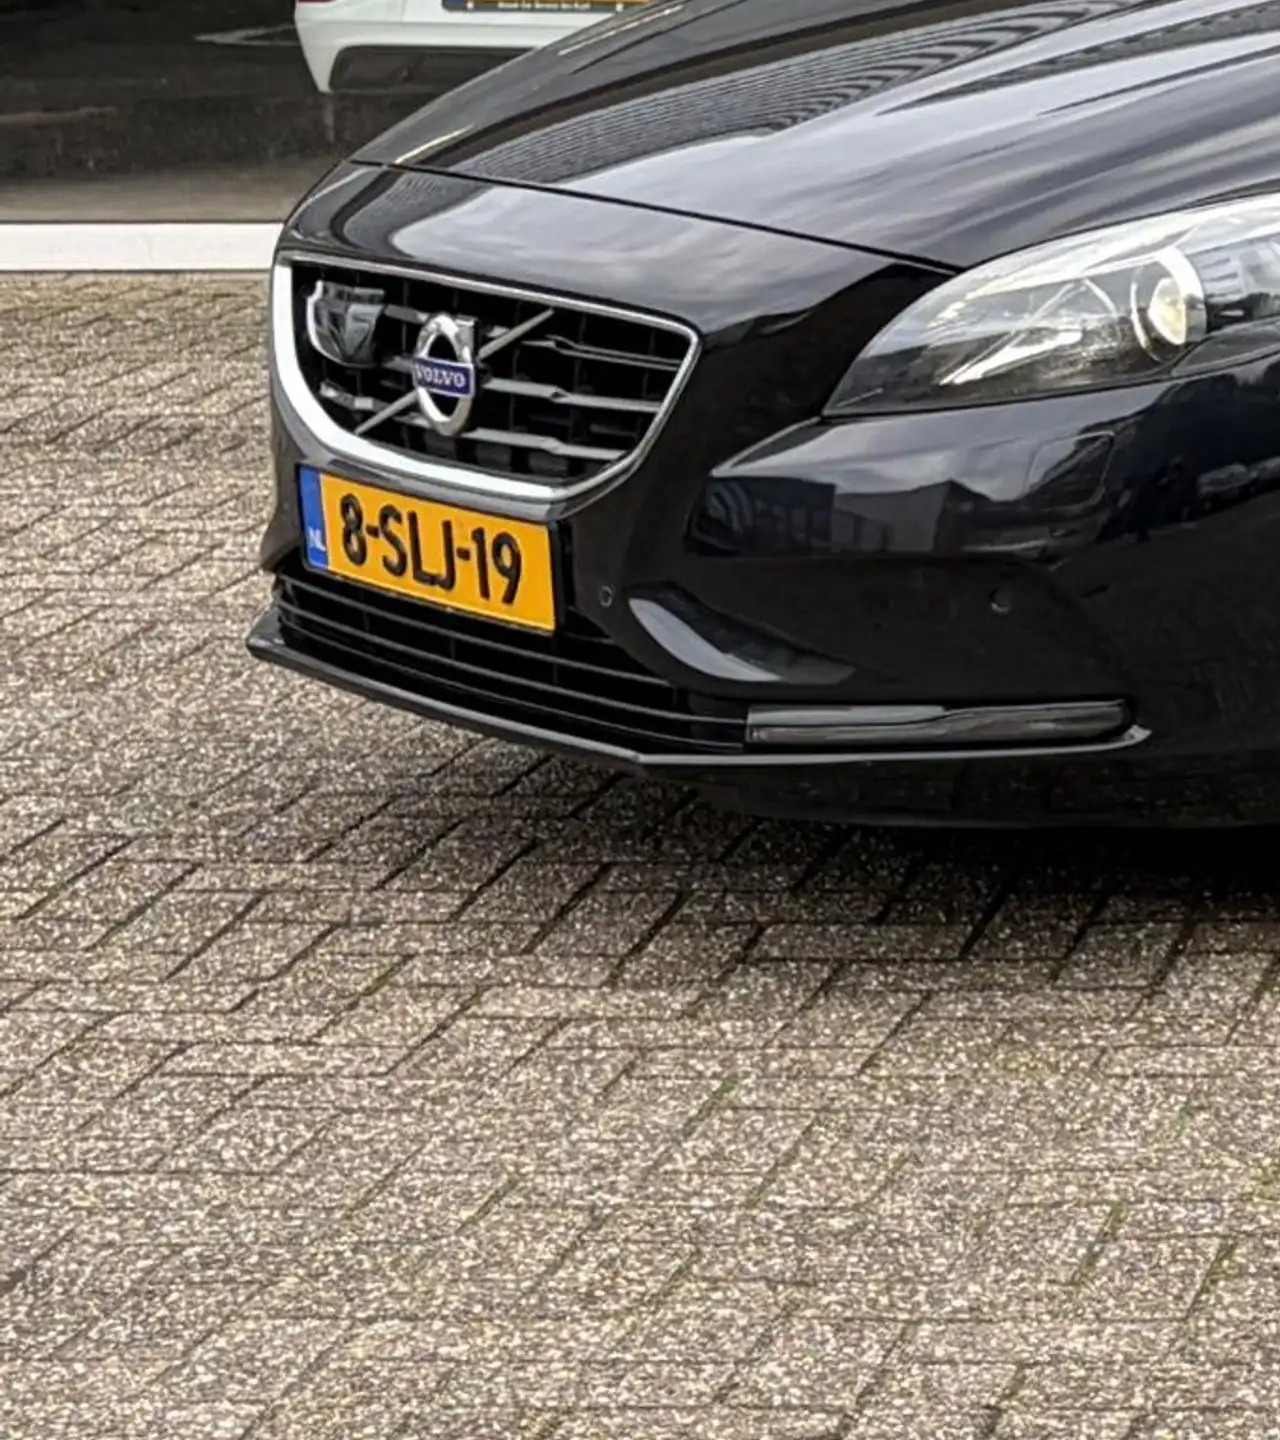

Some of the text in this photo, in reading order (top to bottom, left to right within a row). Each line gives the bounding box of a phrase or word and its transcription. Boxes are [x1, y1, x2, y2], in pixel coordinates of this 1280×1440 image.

[414, 363, 466, 388] VOLVO
[308, 529, 326, 554] NL
[338, 493, 524, 606] 8-SLJ-19
